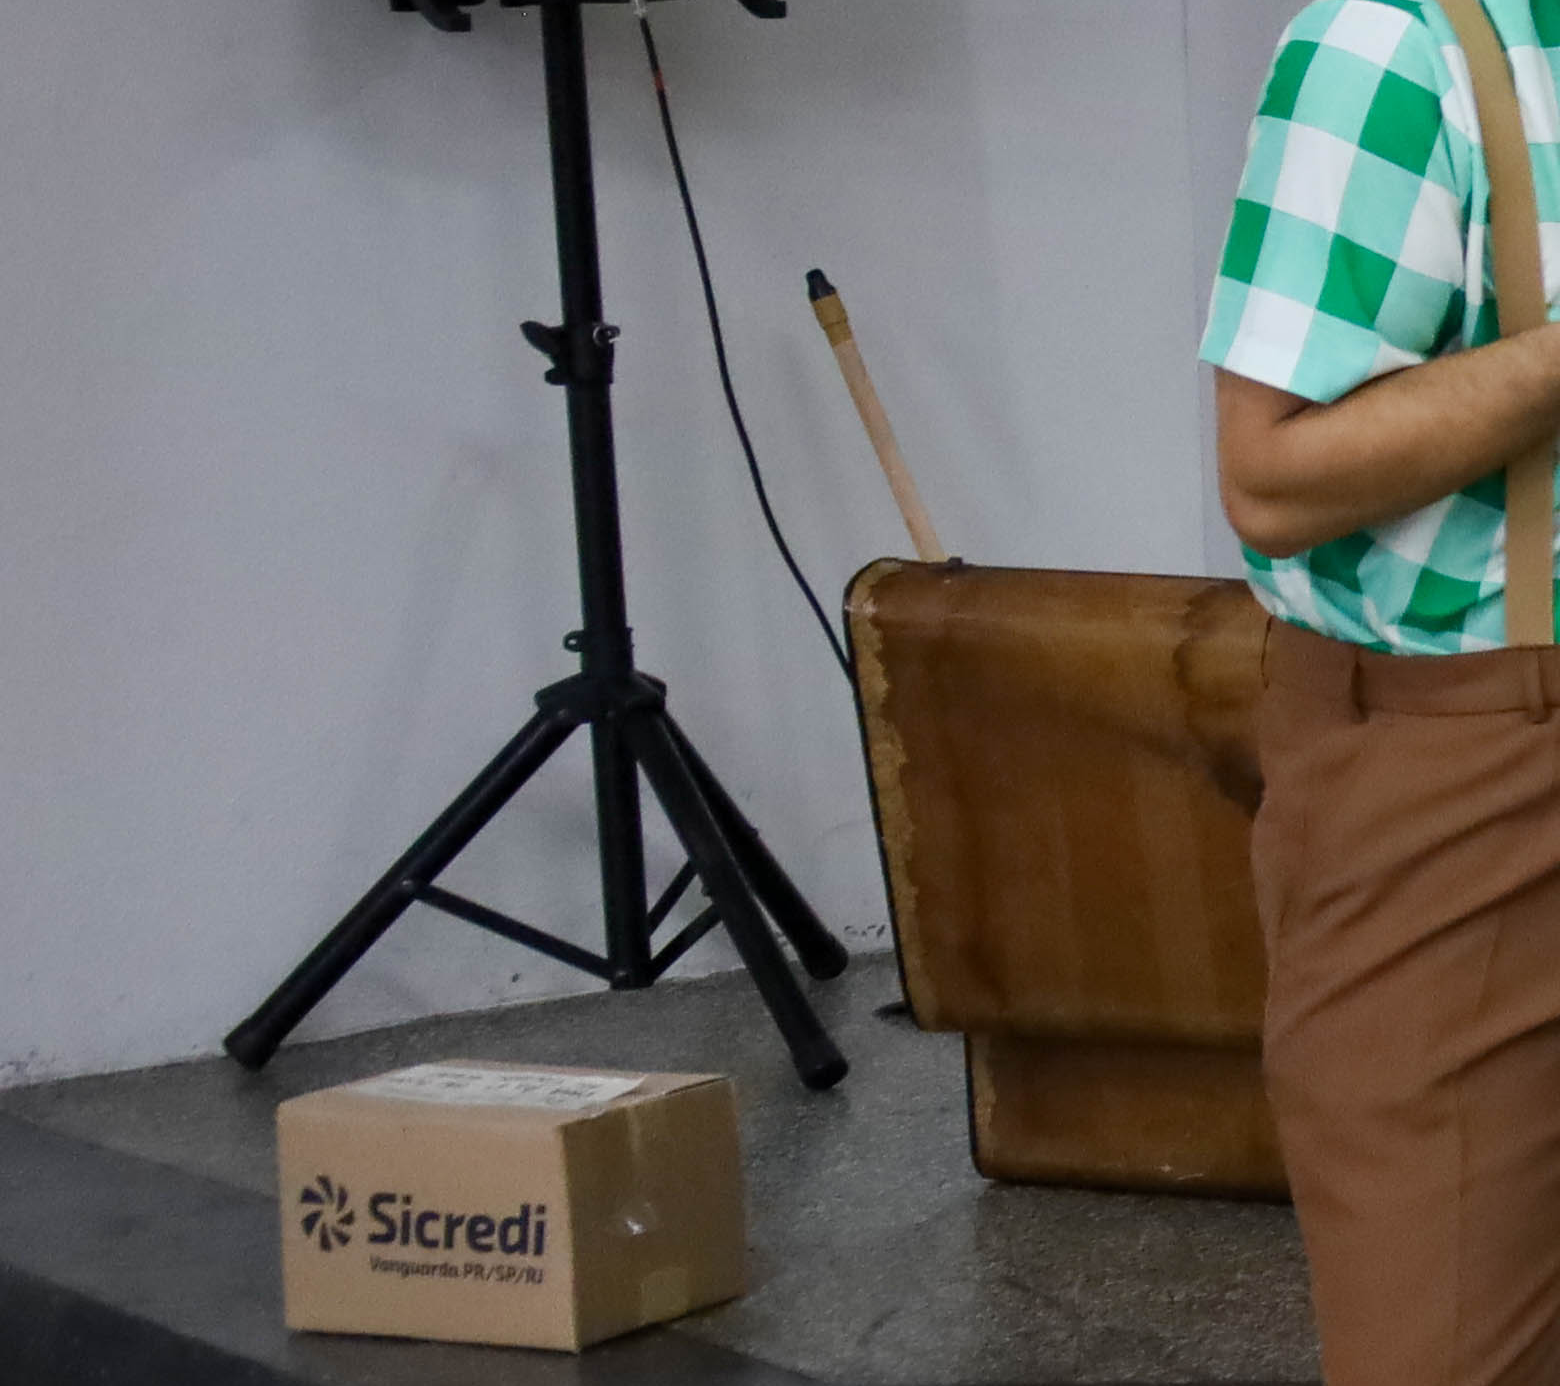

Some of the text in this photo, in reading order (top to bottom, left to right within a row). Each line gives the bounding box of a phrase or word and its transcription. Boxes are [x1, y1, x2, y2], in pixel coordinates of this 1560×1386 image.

[367, 1191, 547, 1256] Sicredi
[369, 1255, 544, 1285] Vanguarda PR/SP/RJ
